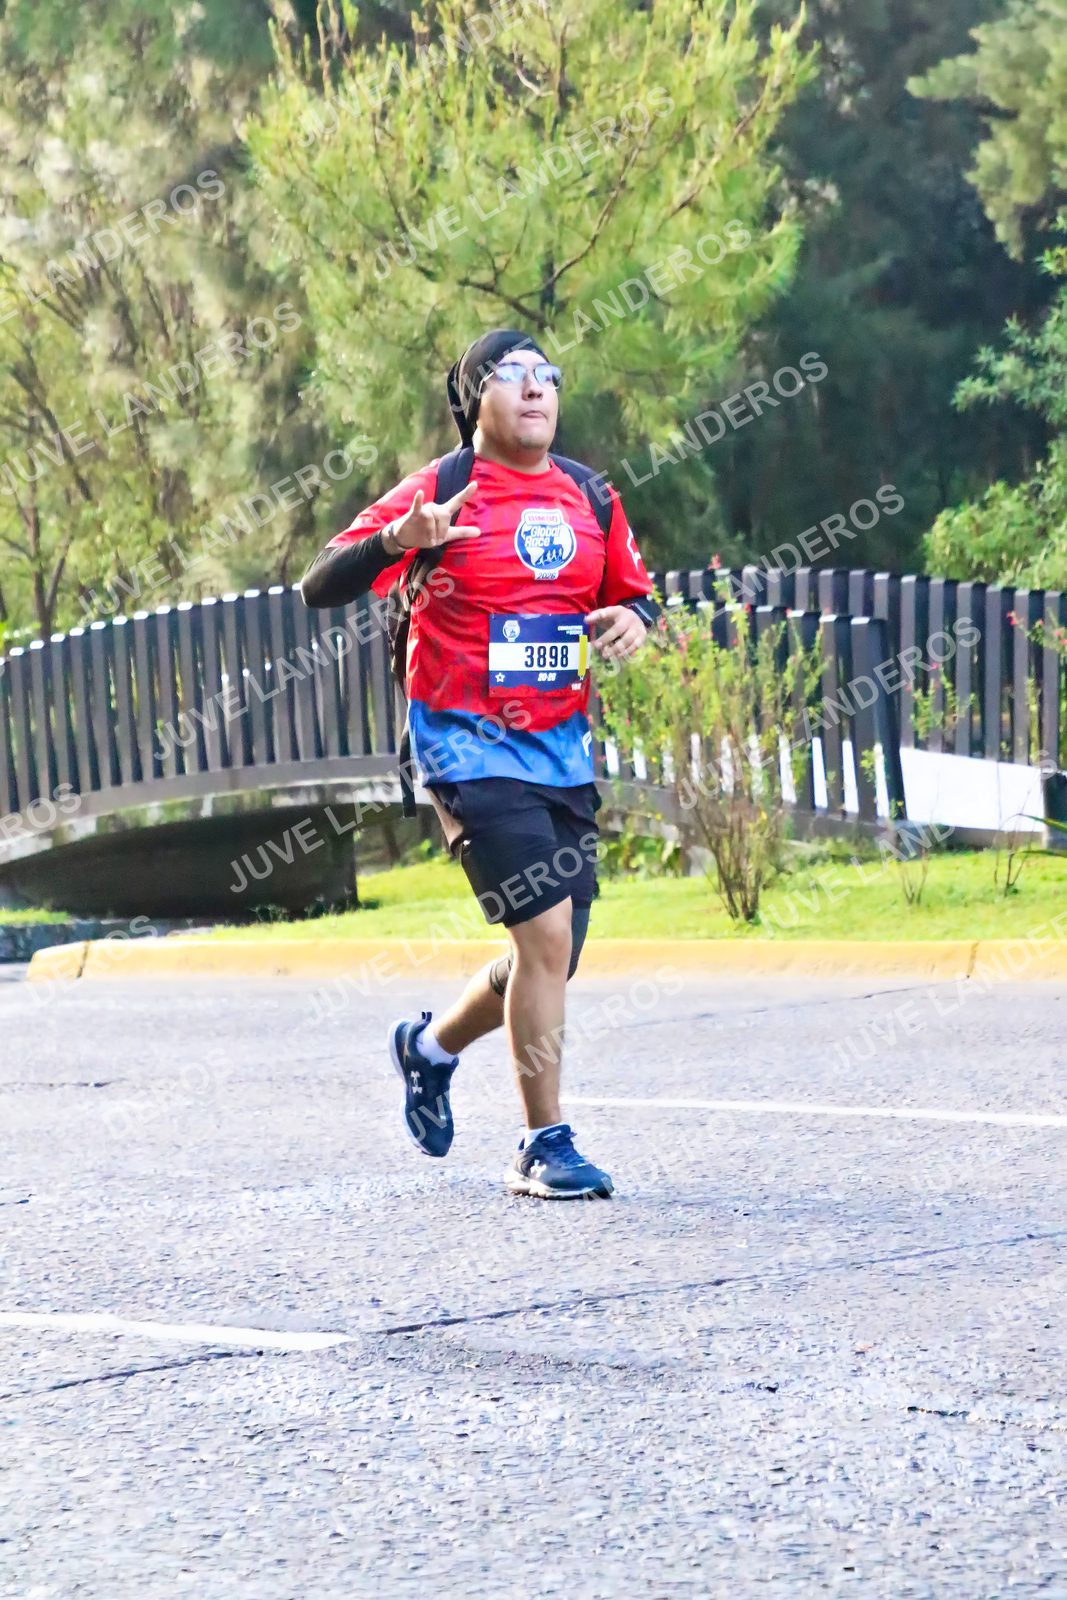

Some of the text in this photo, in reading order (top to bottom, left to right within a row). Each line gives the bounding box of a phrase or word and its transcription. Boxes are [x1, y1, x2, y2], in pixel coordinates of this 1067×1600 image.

[530, 525, 560, 537] Global
[525, 536, 550, 547] Race
[524, 645, 569, 668] 3898
